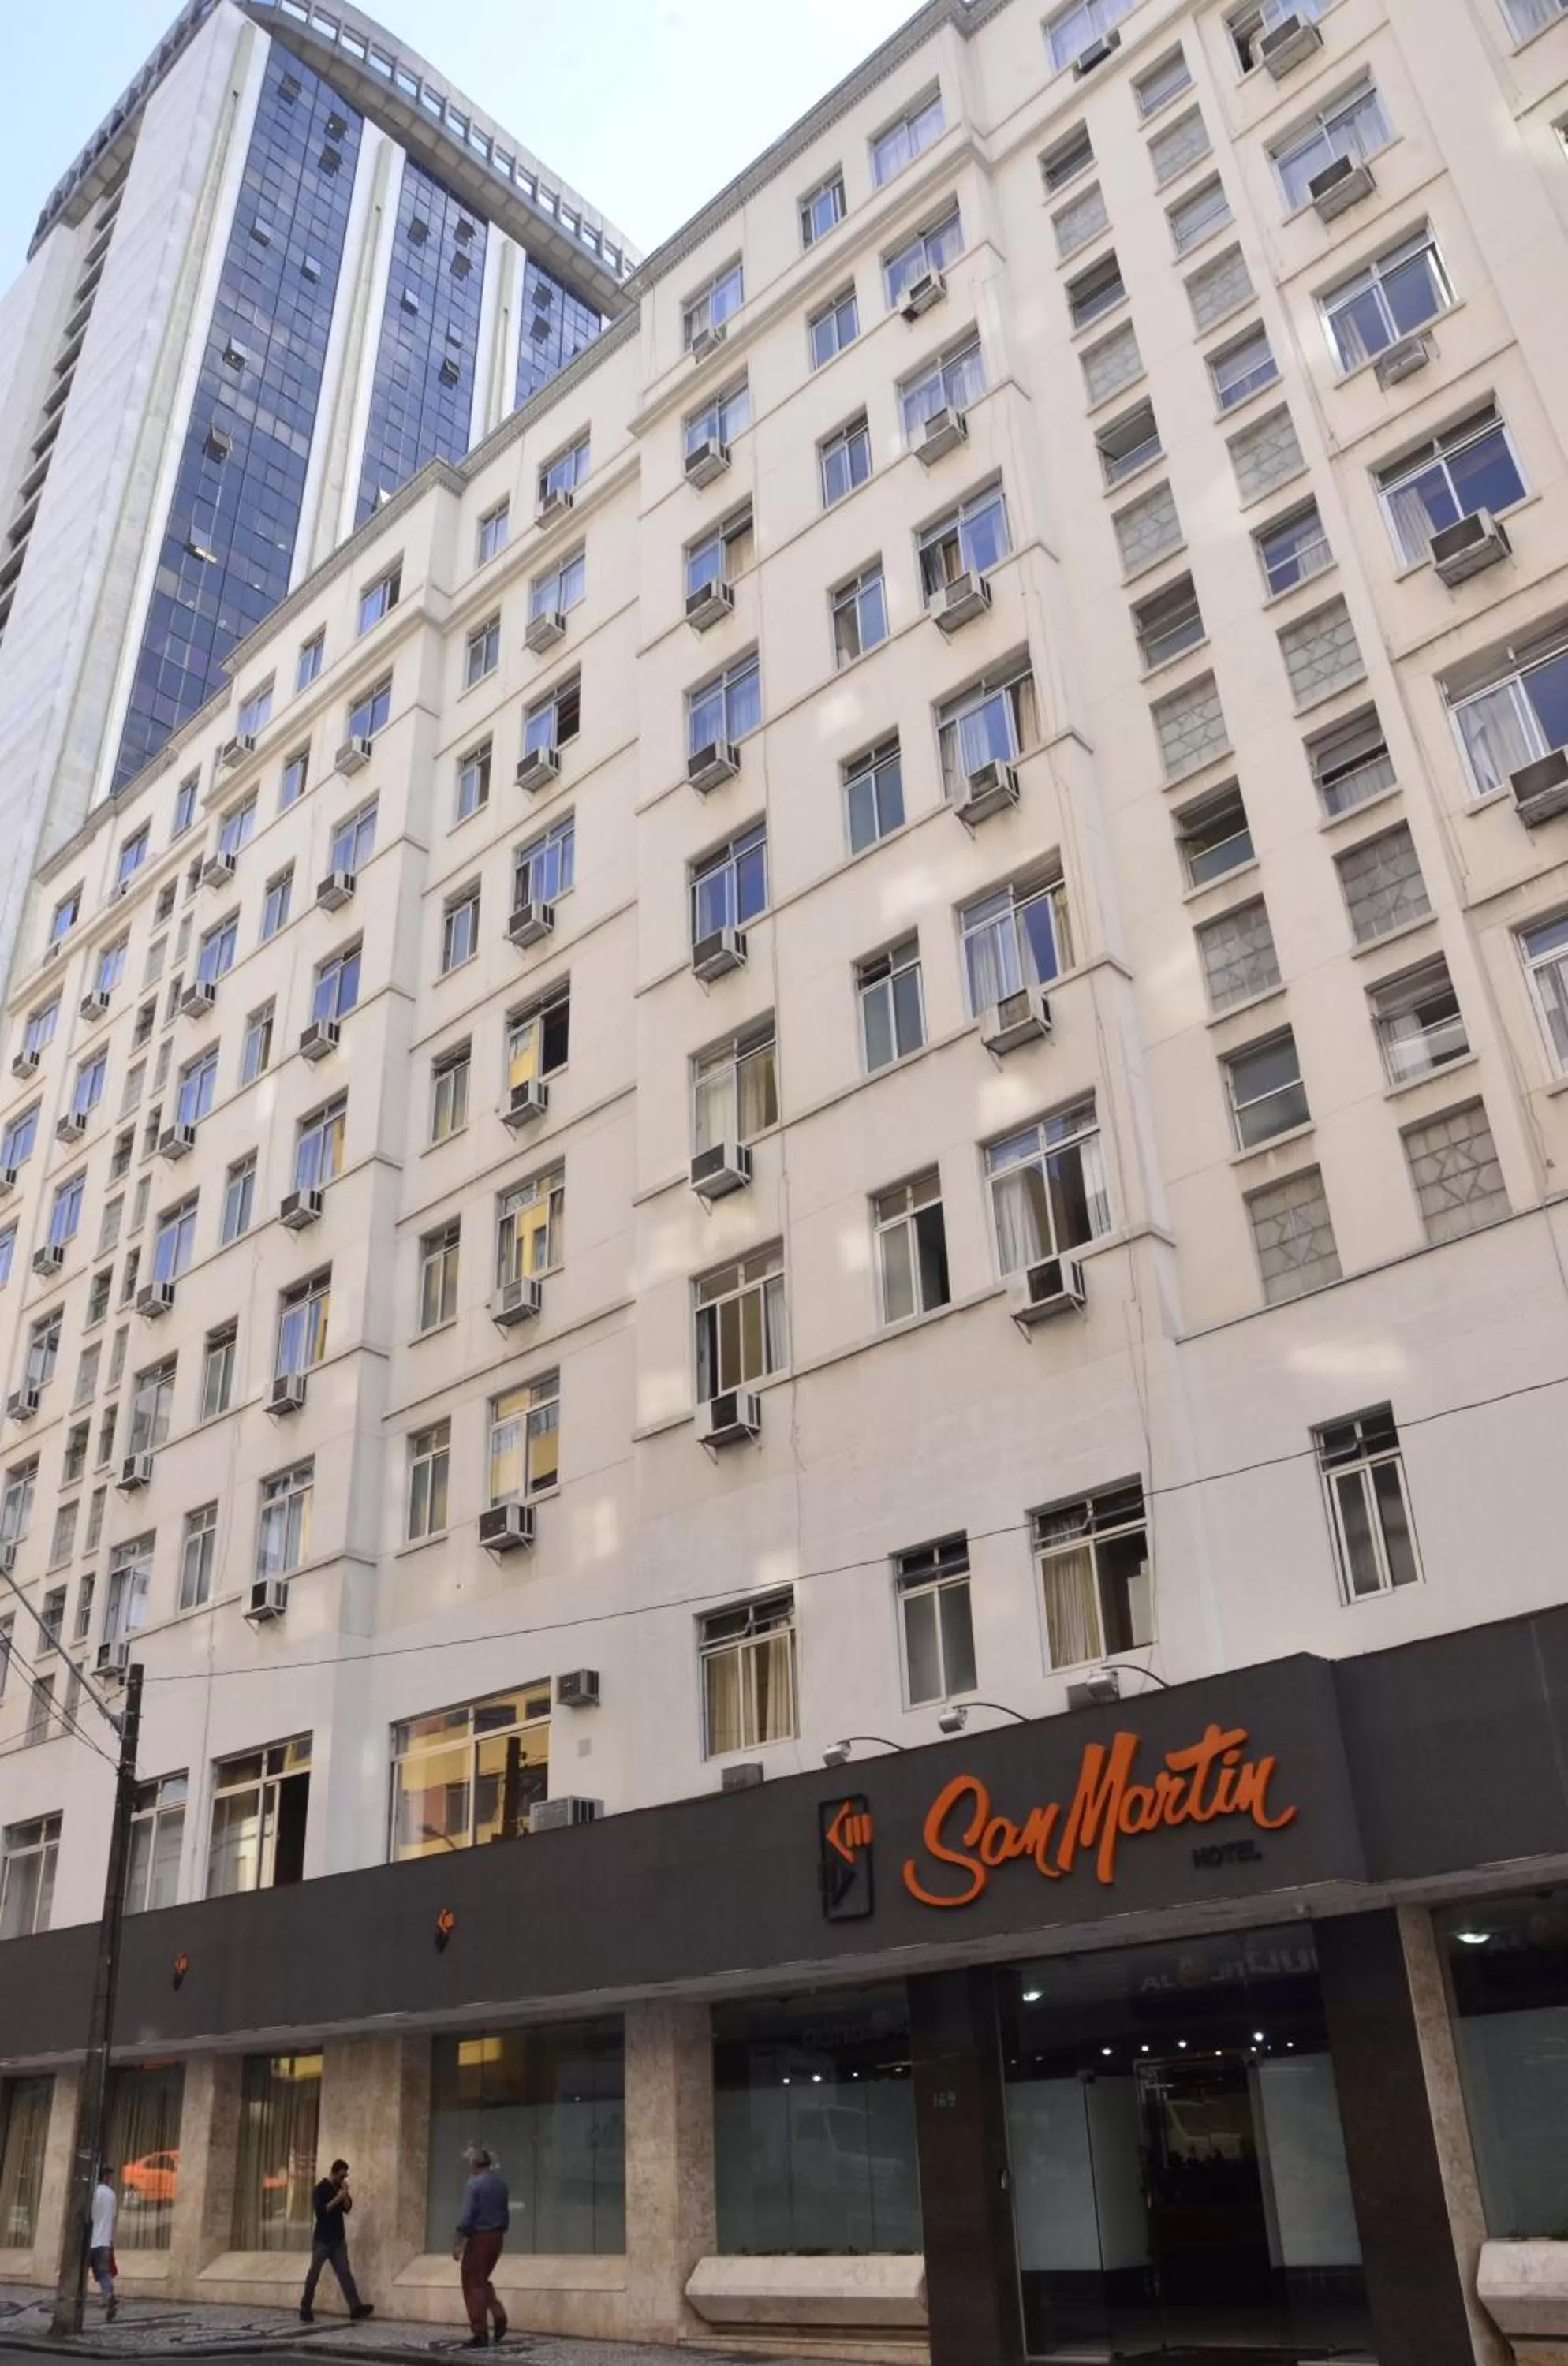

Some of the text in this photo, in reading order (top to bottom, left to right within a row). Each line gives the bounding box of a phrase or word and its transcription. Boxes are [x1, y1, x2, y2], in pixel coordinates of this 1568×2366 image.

[903, 1724, 1298, 1906] San Martin
[1193, 1839, 1262, 1870] HOTEL
